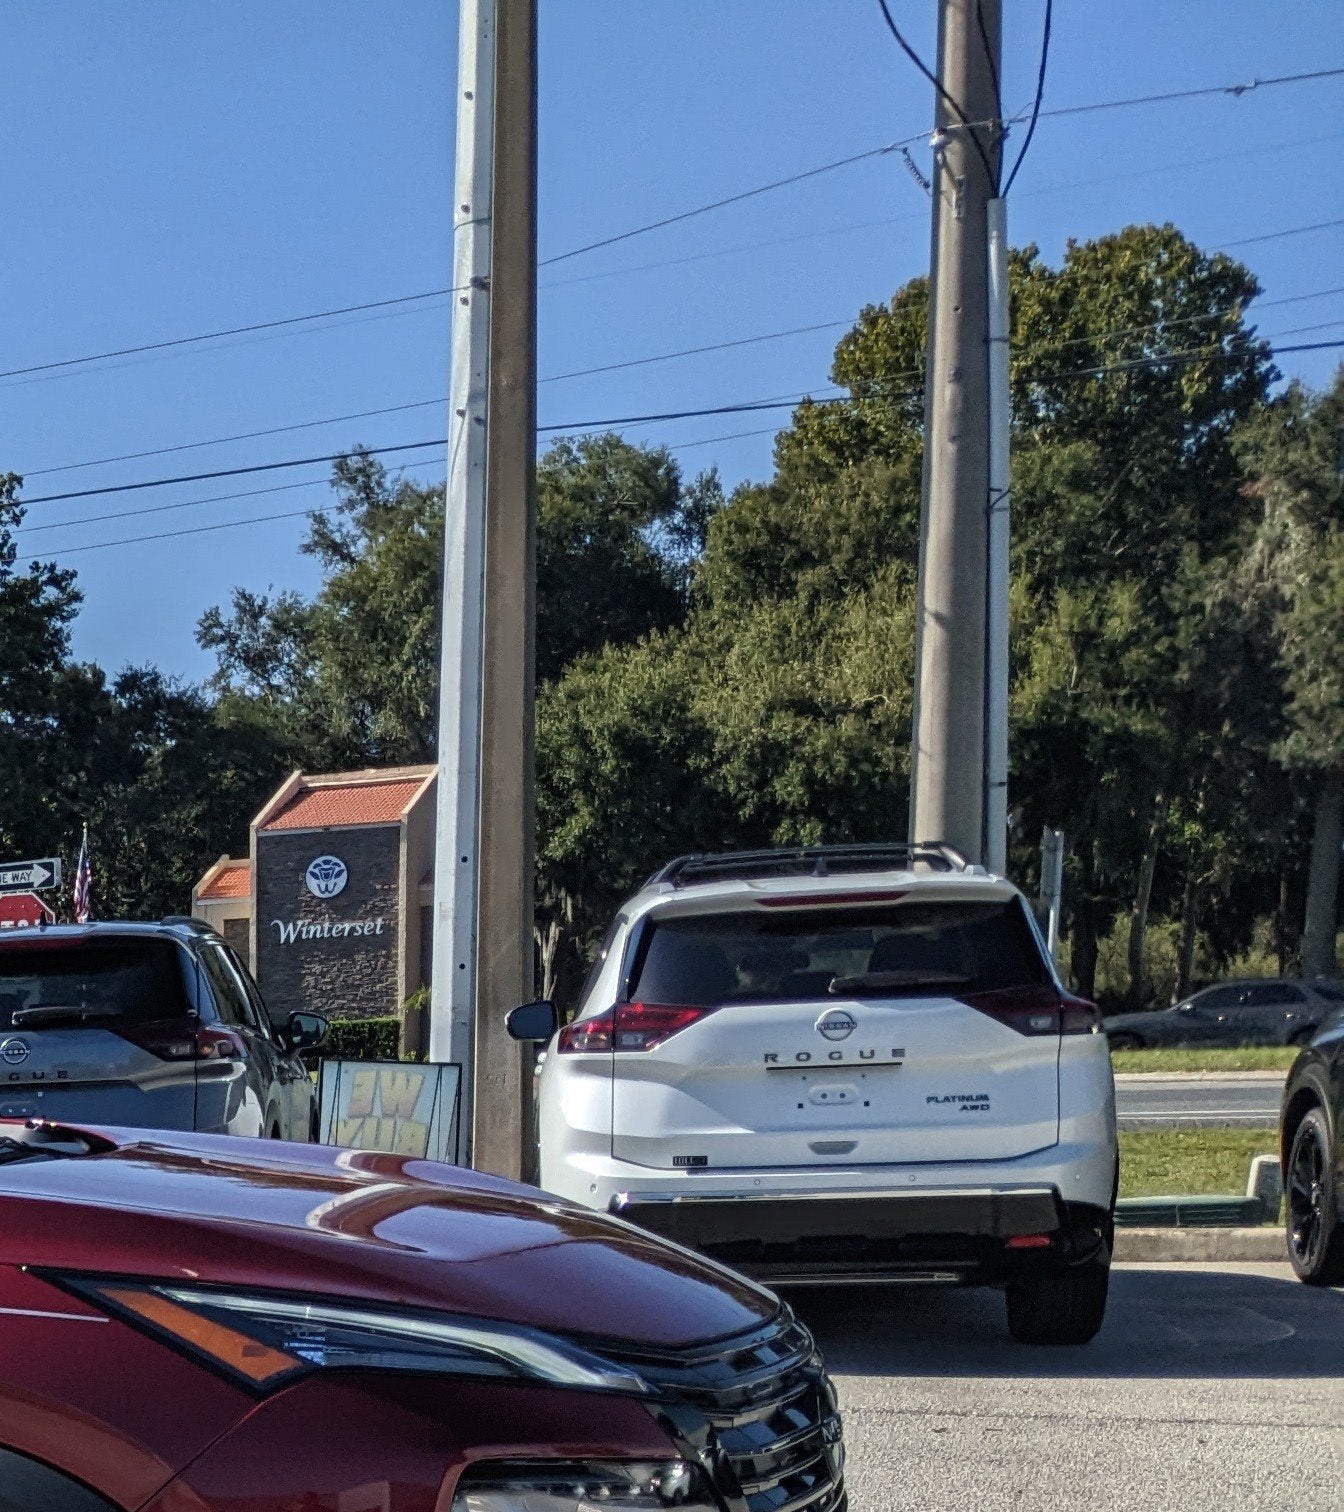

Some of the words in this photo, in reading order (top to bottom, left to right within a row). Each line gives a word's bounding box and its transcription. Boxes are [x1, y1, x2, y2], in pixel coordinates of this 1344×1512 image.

[11, 870, 33, 883] WAY
[270, 918, 384, 944] Winterset
[764, 1048, 906, 1063] ROGUE
[926, 1094, 990, 1104] PLATINUM
